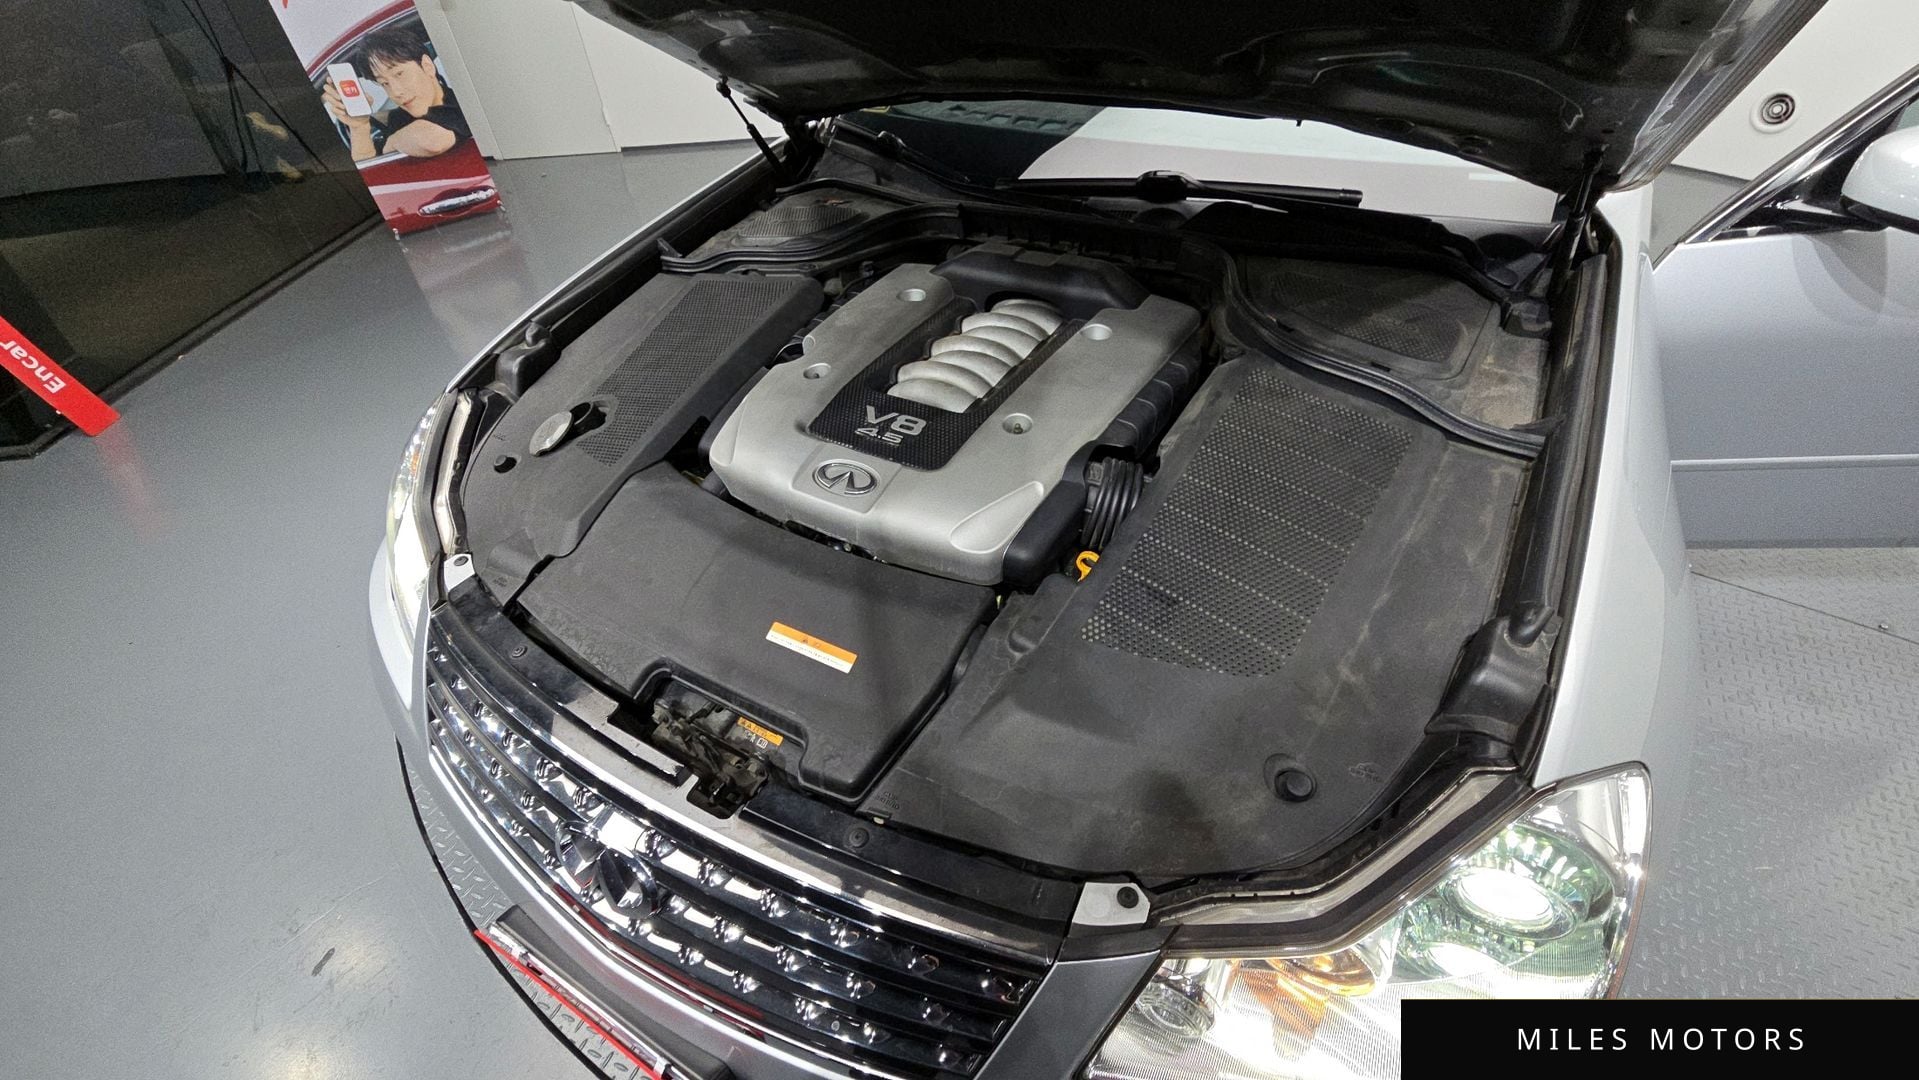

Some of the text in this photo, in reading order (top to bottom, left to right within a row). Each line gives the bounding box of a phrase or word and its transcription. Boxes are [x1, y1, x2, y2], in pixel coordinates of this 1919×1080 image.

[0, 340, 66, 393] Encar
[854, 427, 904, 444] 4.5
[866, 405, 927, 436] V8
